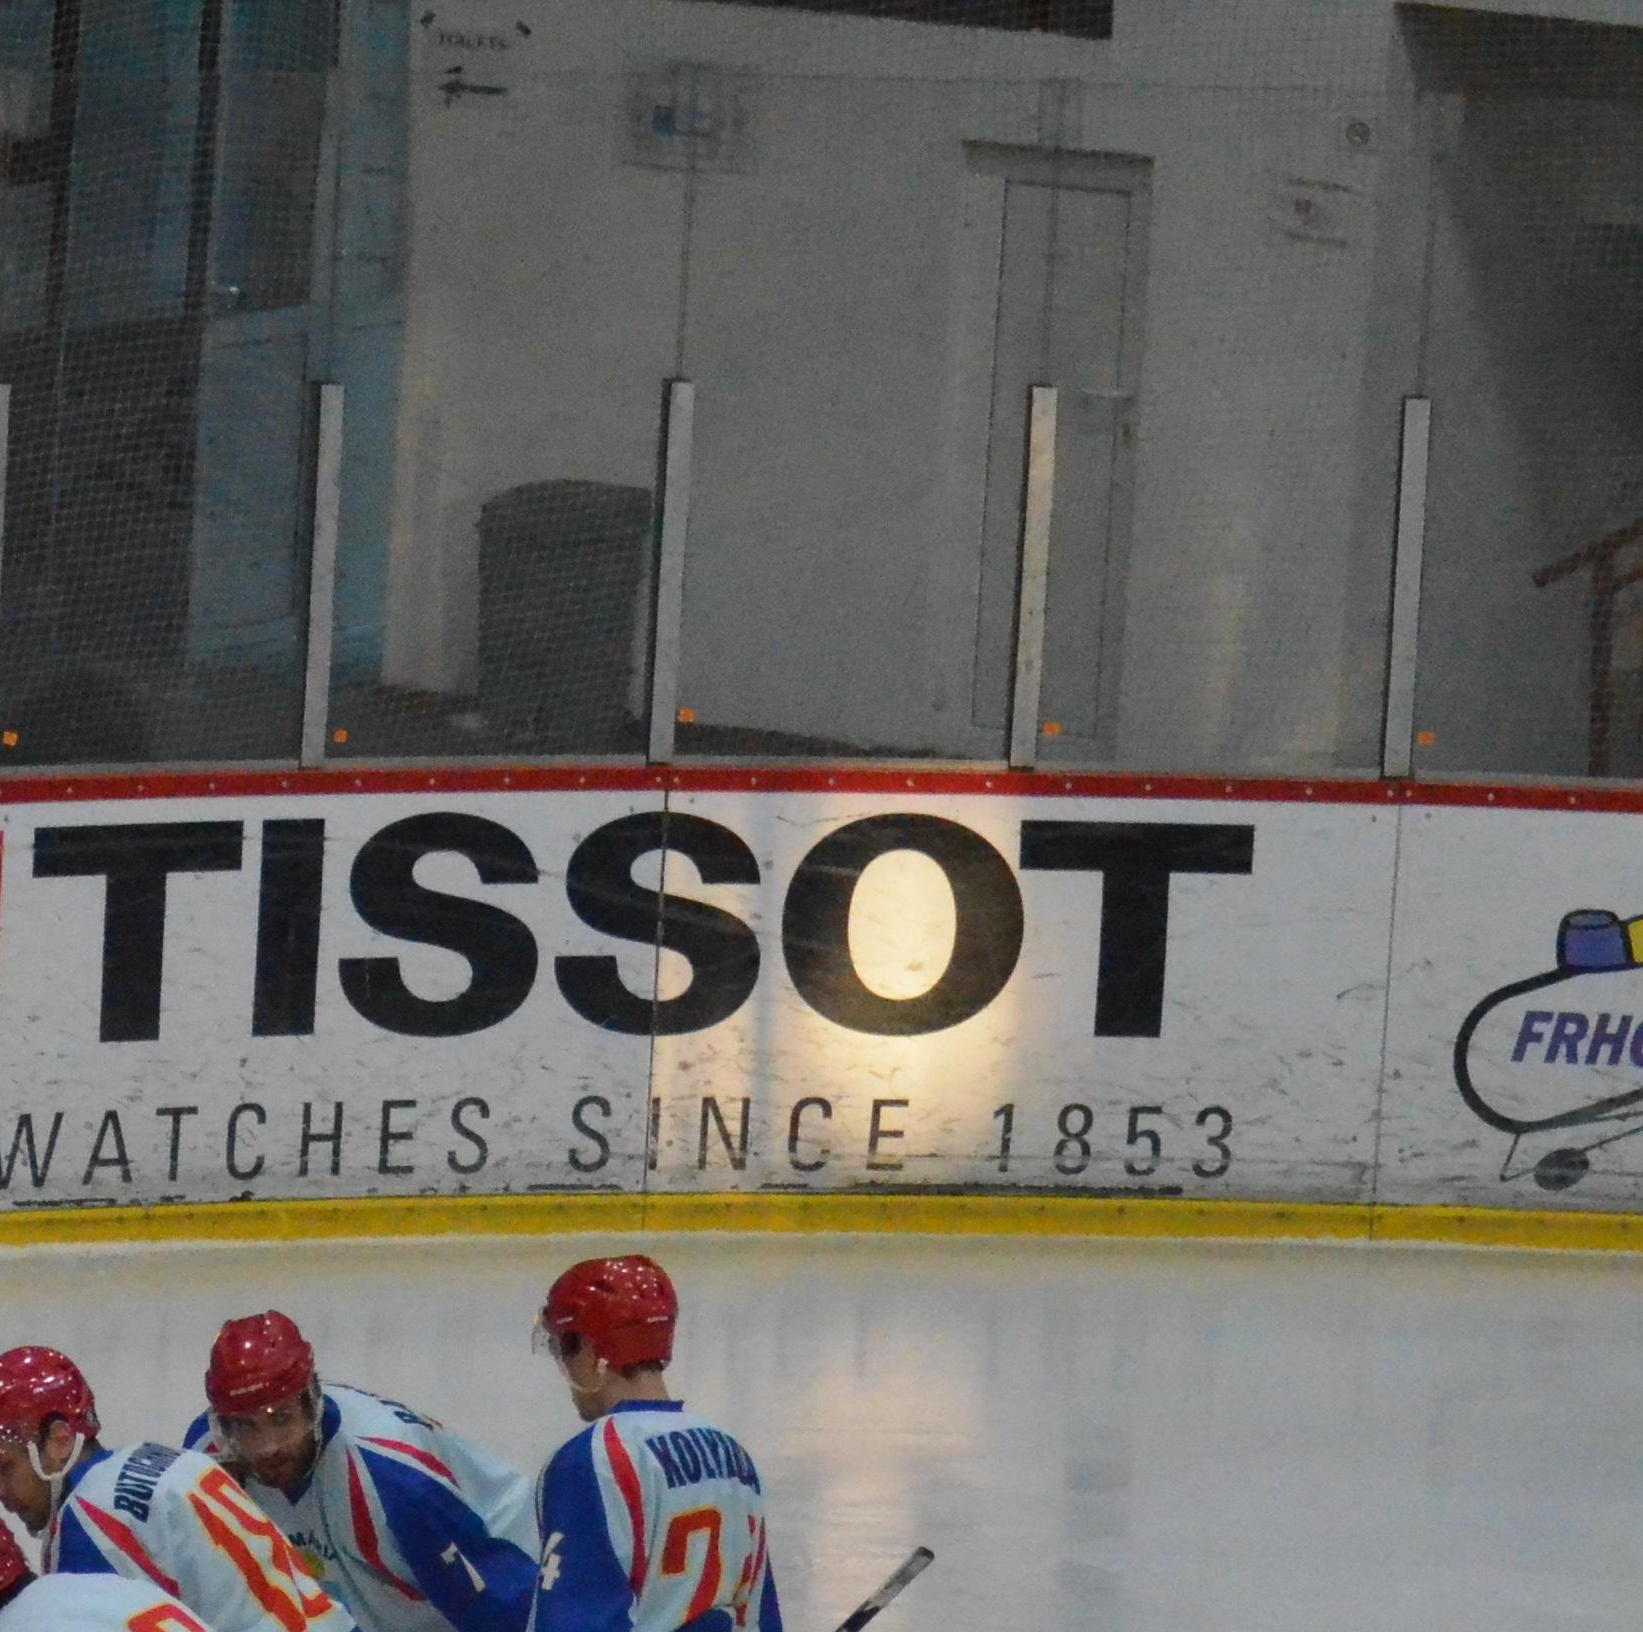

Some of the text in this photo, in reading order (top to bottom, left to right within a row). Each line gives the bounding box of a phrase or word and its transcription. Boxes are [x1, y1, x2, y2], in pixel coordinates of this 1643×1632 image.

[32, 811, 1253, 1042] TISSOT
[1510, 1010, 1643, 1067] FRH
[568, 1095, 911, 1173] SINCE
[993, 1101, 1235, 1178] 1853
